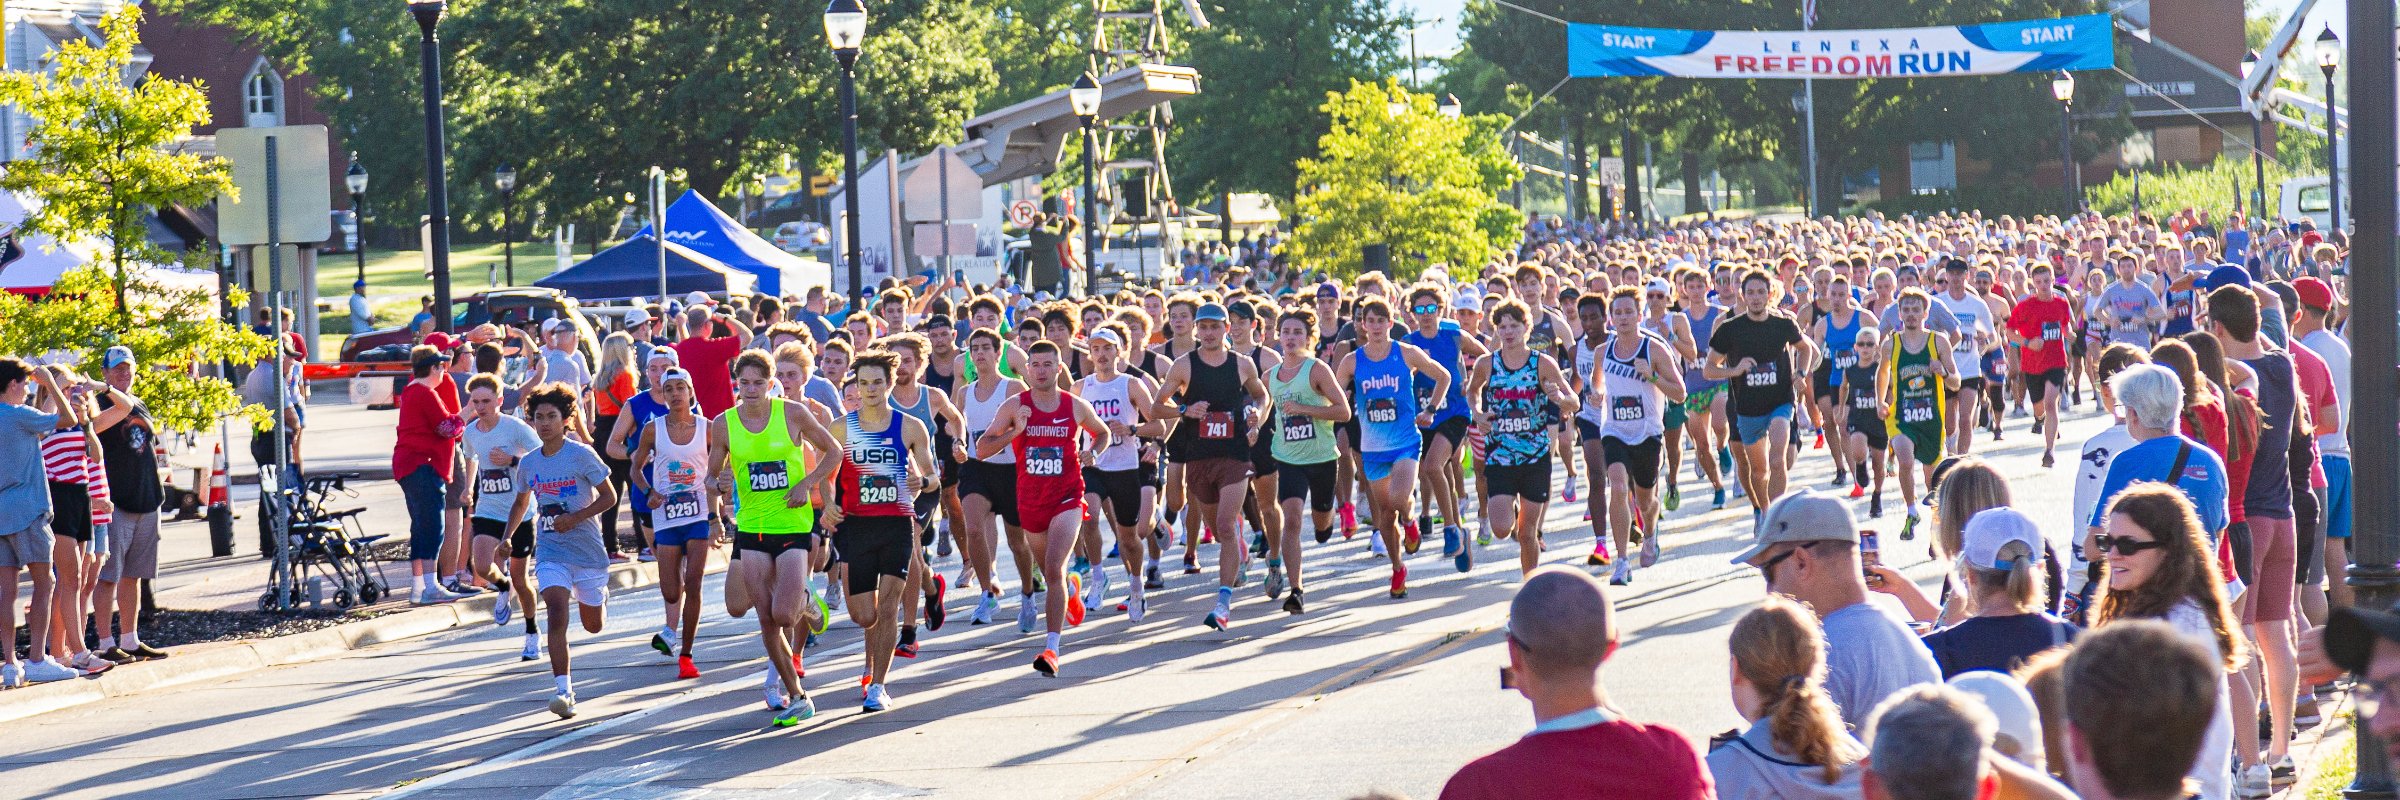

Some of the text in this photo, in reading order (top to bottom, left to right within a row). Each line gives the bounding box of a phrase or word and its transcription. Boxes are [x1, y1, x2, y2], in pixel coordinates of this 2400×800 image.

[1603, 32, 1656, 49] START
[2020, 25, 2076, 45] START
[1714, 50, 1971, 76] FREEDOM RUN
[1361, 373, 1400, 395] philly
[1746, 371, 1777, 387] 3328
[1091, 398, 1120, 418] CTC
[1368, 408, 1397, 423] 1963
[1614, 406, 1643, 420] 1953
[1903, 406, 1934, 422] 3424
[1026, 425, 1069, 438] SOUTHWEST
[1206, 422, 1227, 437] 741
[1285, 423, 1313, 440] 2627
[1497, 416, 1531, 432] 2595
[853, 447, 899, 465] USA
[1025, 458, 1063, 475] 3298
[482, 477, 511, 492] 2818
[537, 479, 576, 489] FREEDOM
[750, 471, 789, 490] 2905
[860, 486, 897, 503] 3249
[666, 500, 699, 518] 3251
[541, 515, 560, 531] 29
